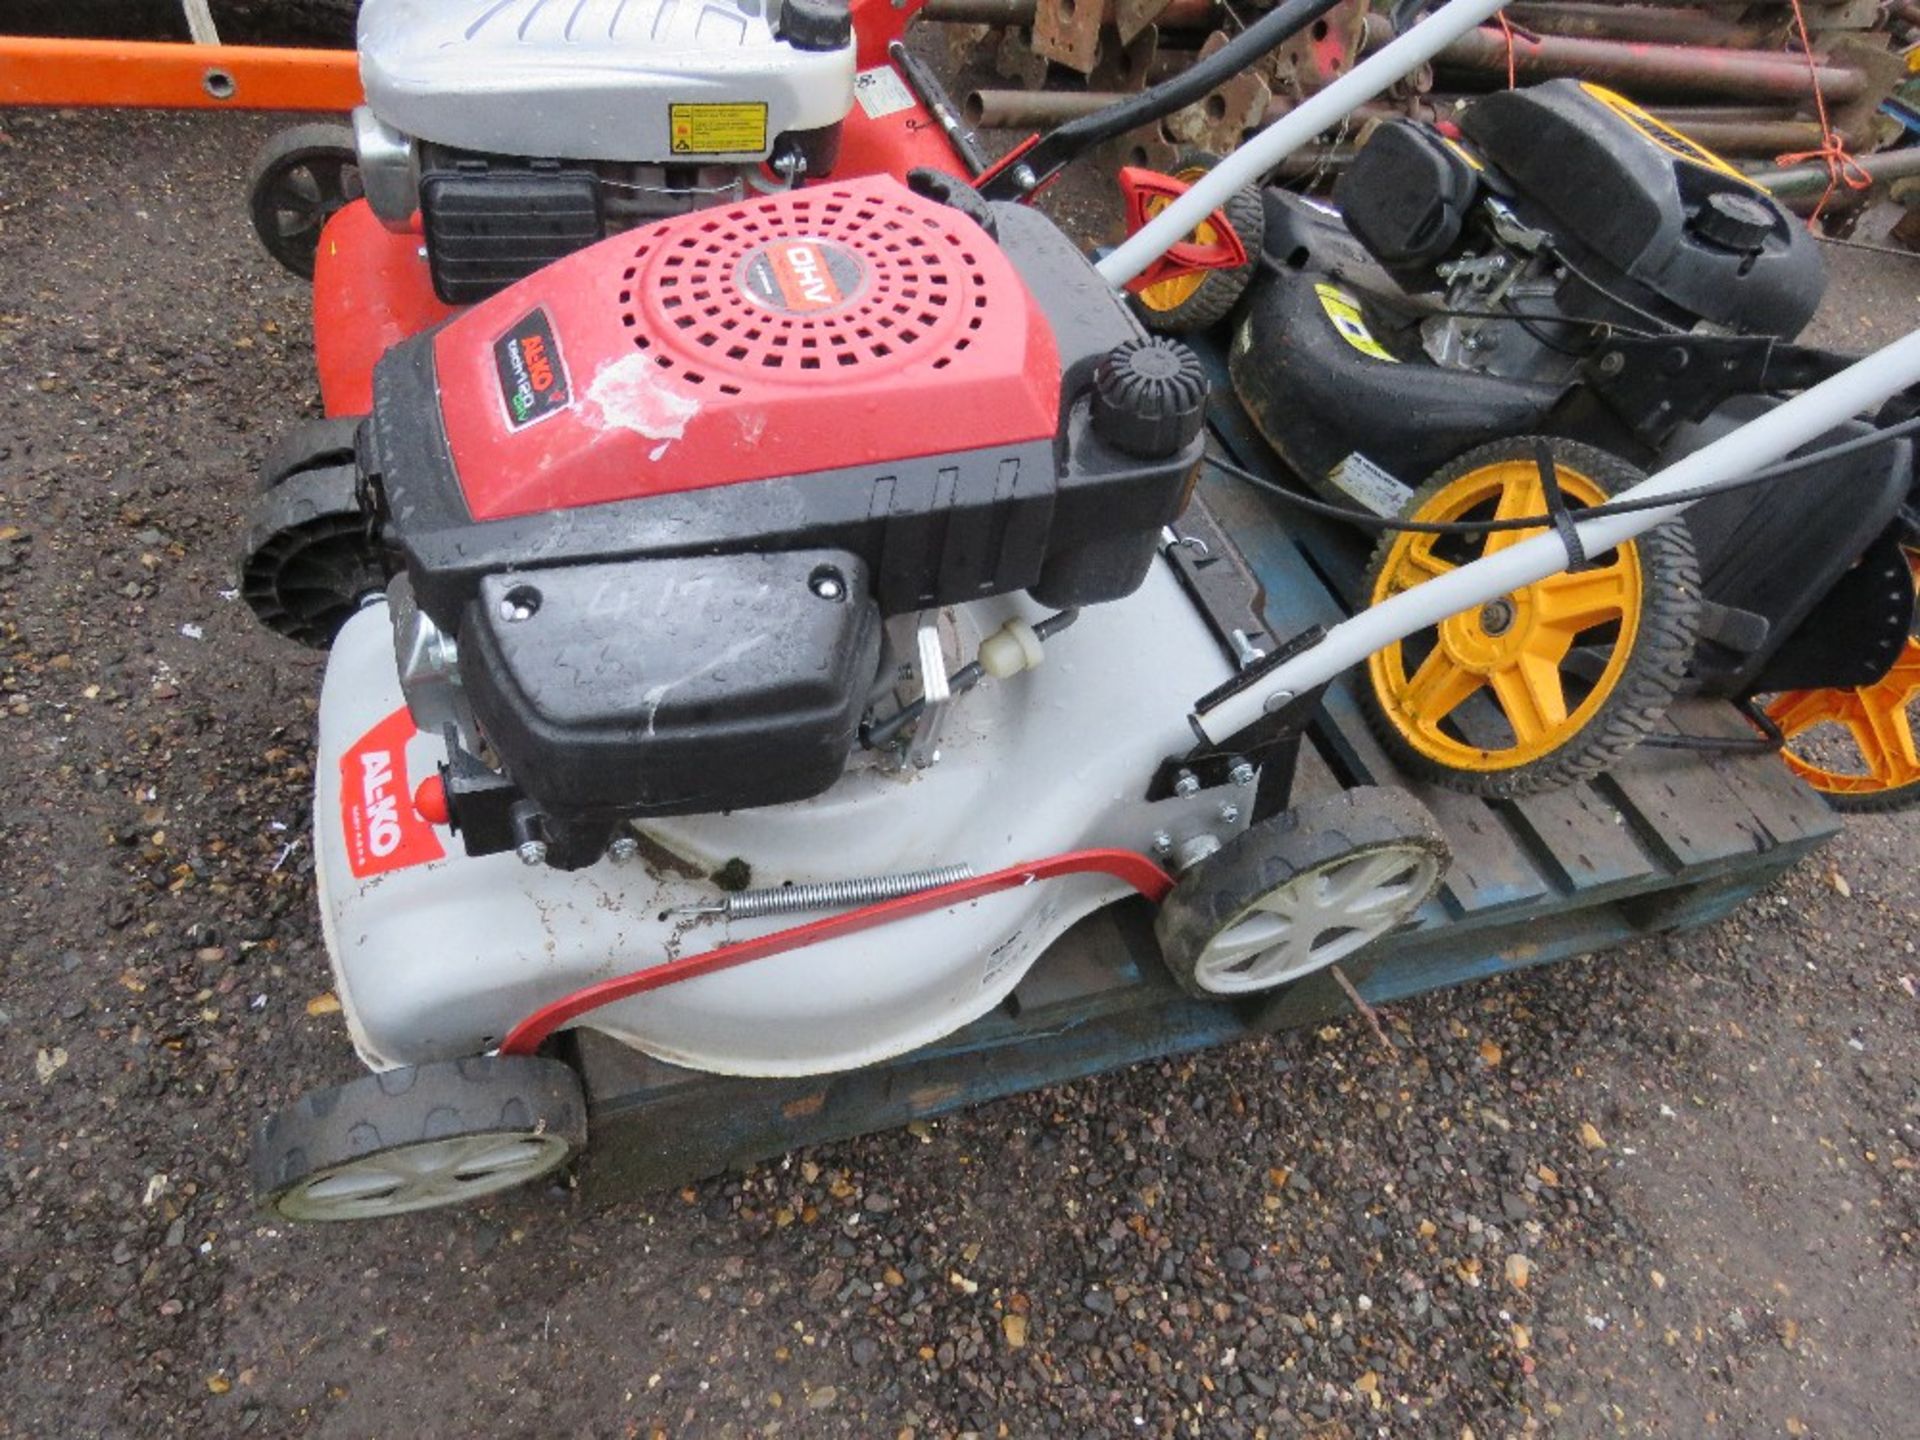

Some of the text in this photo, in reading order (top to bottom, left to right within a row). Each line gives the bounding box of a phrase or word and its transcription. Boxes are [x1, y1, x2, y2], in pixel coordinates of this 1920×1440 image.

[787, 247, 833, 303] OHV
[521, 335, 554, 392] AL-KO
[360, 750, 401, 857] AL-KO
